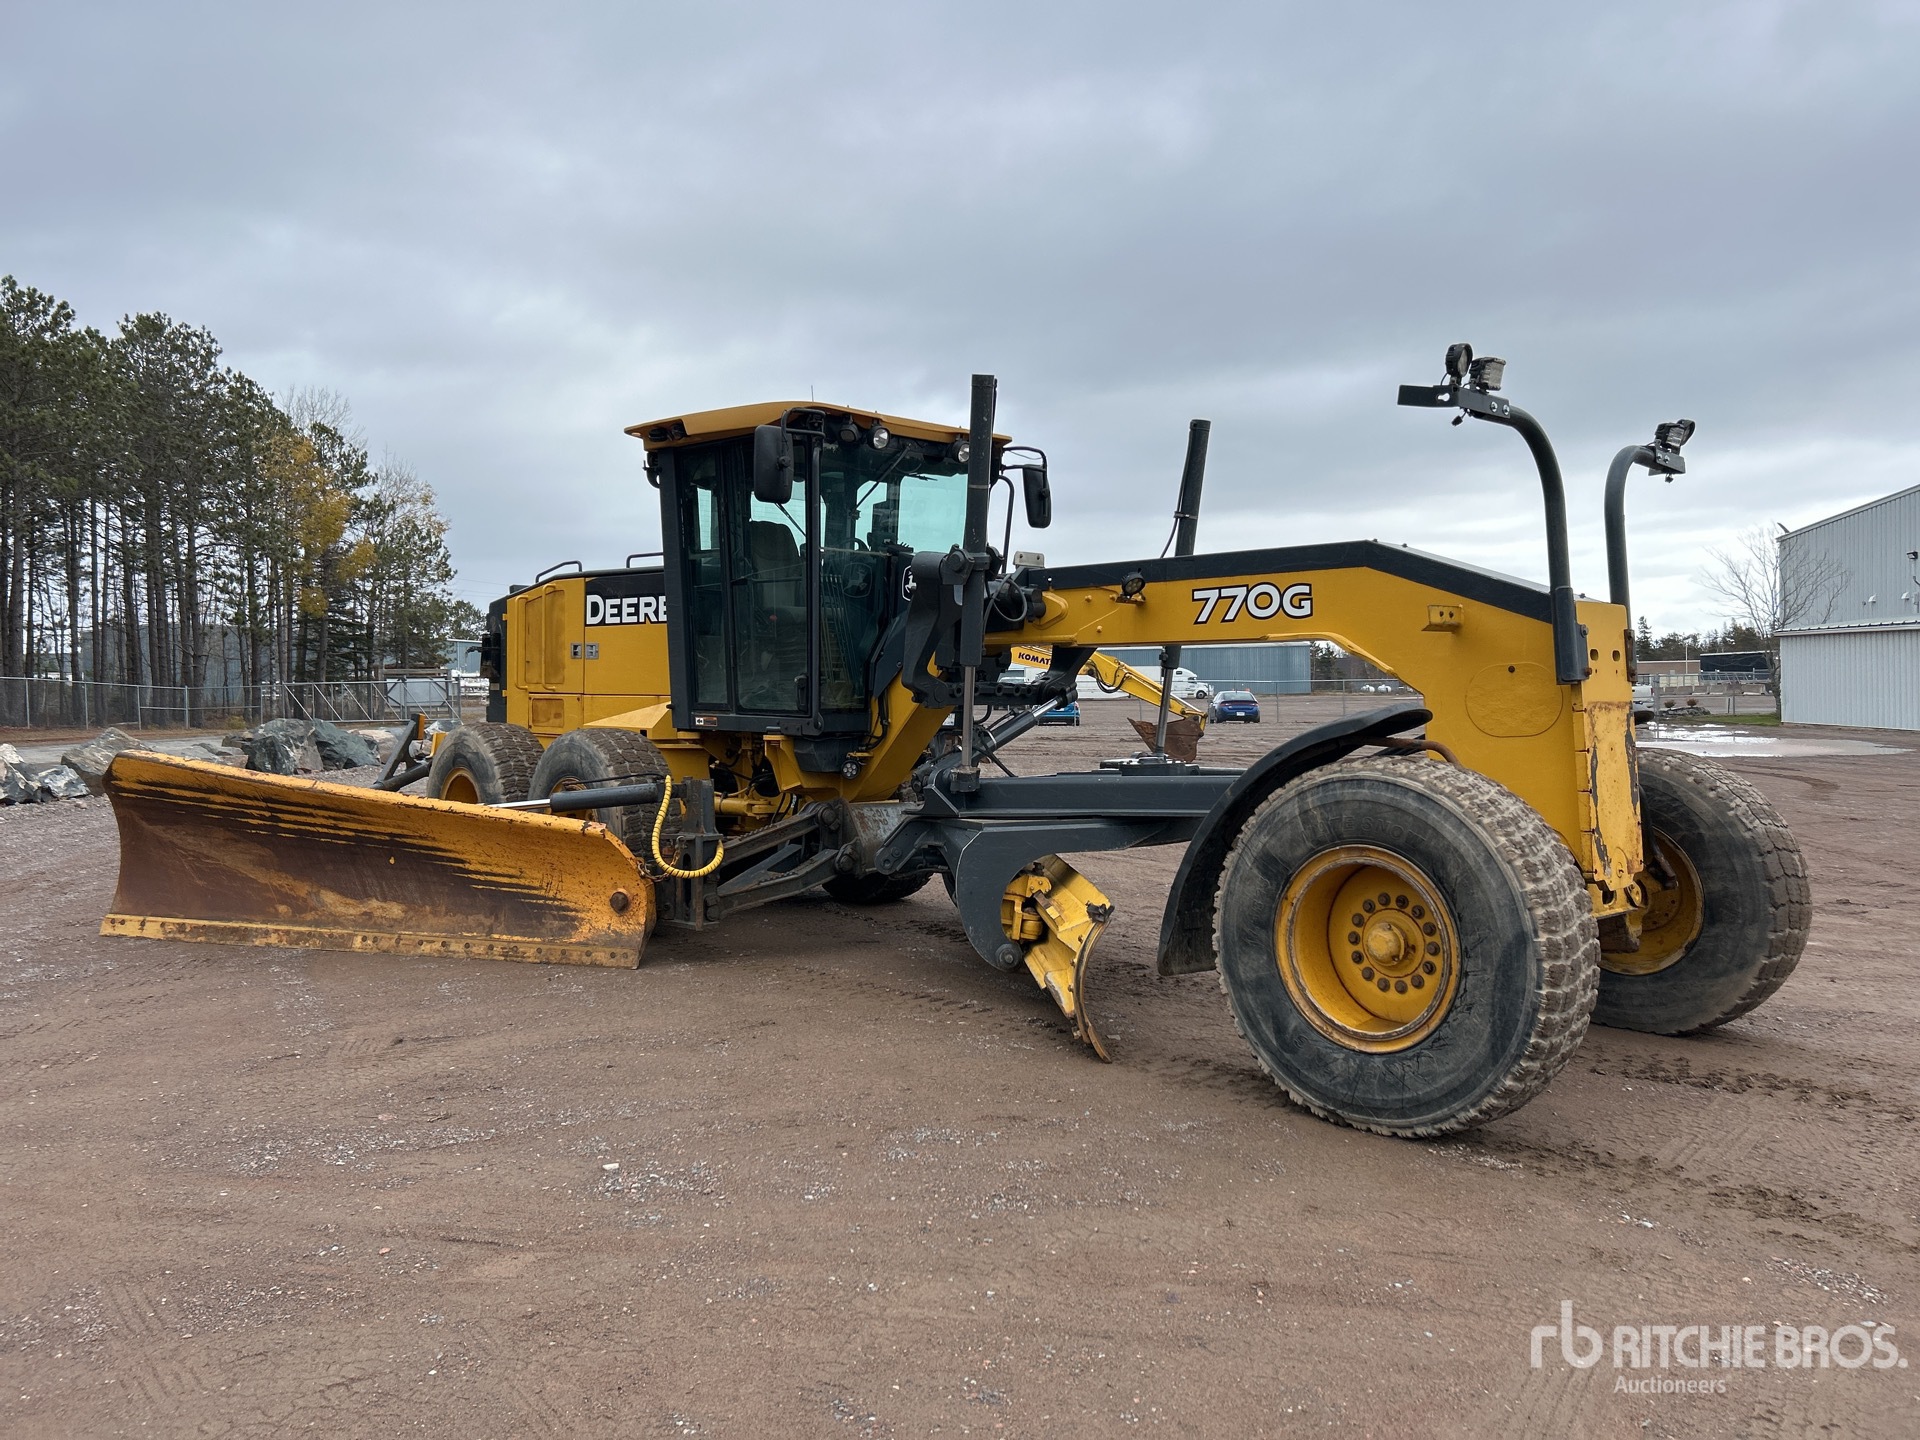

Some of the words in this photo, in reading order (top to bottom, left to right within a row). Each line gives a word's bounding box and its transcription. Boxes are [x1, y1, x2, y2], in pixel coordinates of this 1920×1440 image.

[586, 594, 667, 625] DEERE
[1192, 582, 1313, 624] 770G
[1018, 652, 1051, 665] KOMAT
